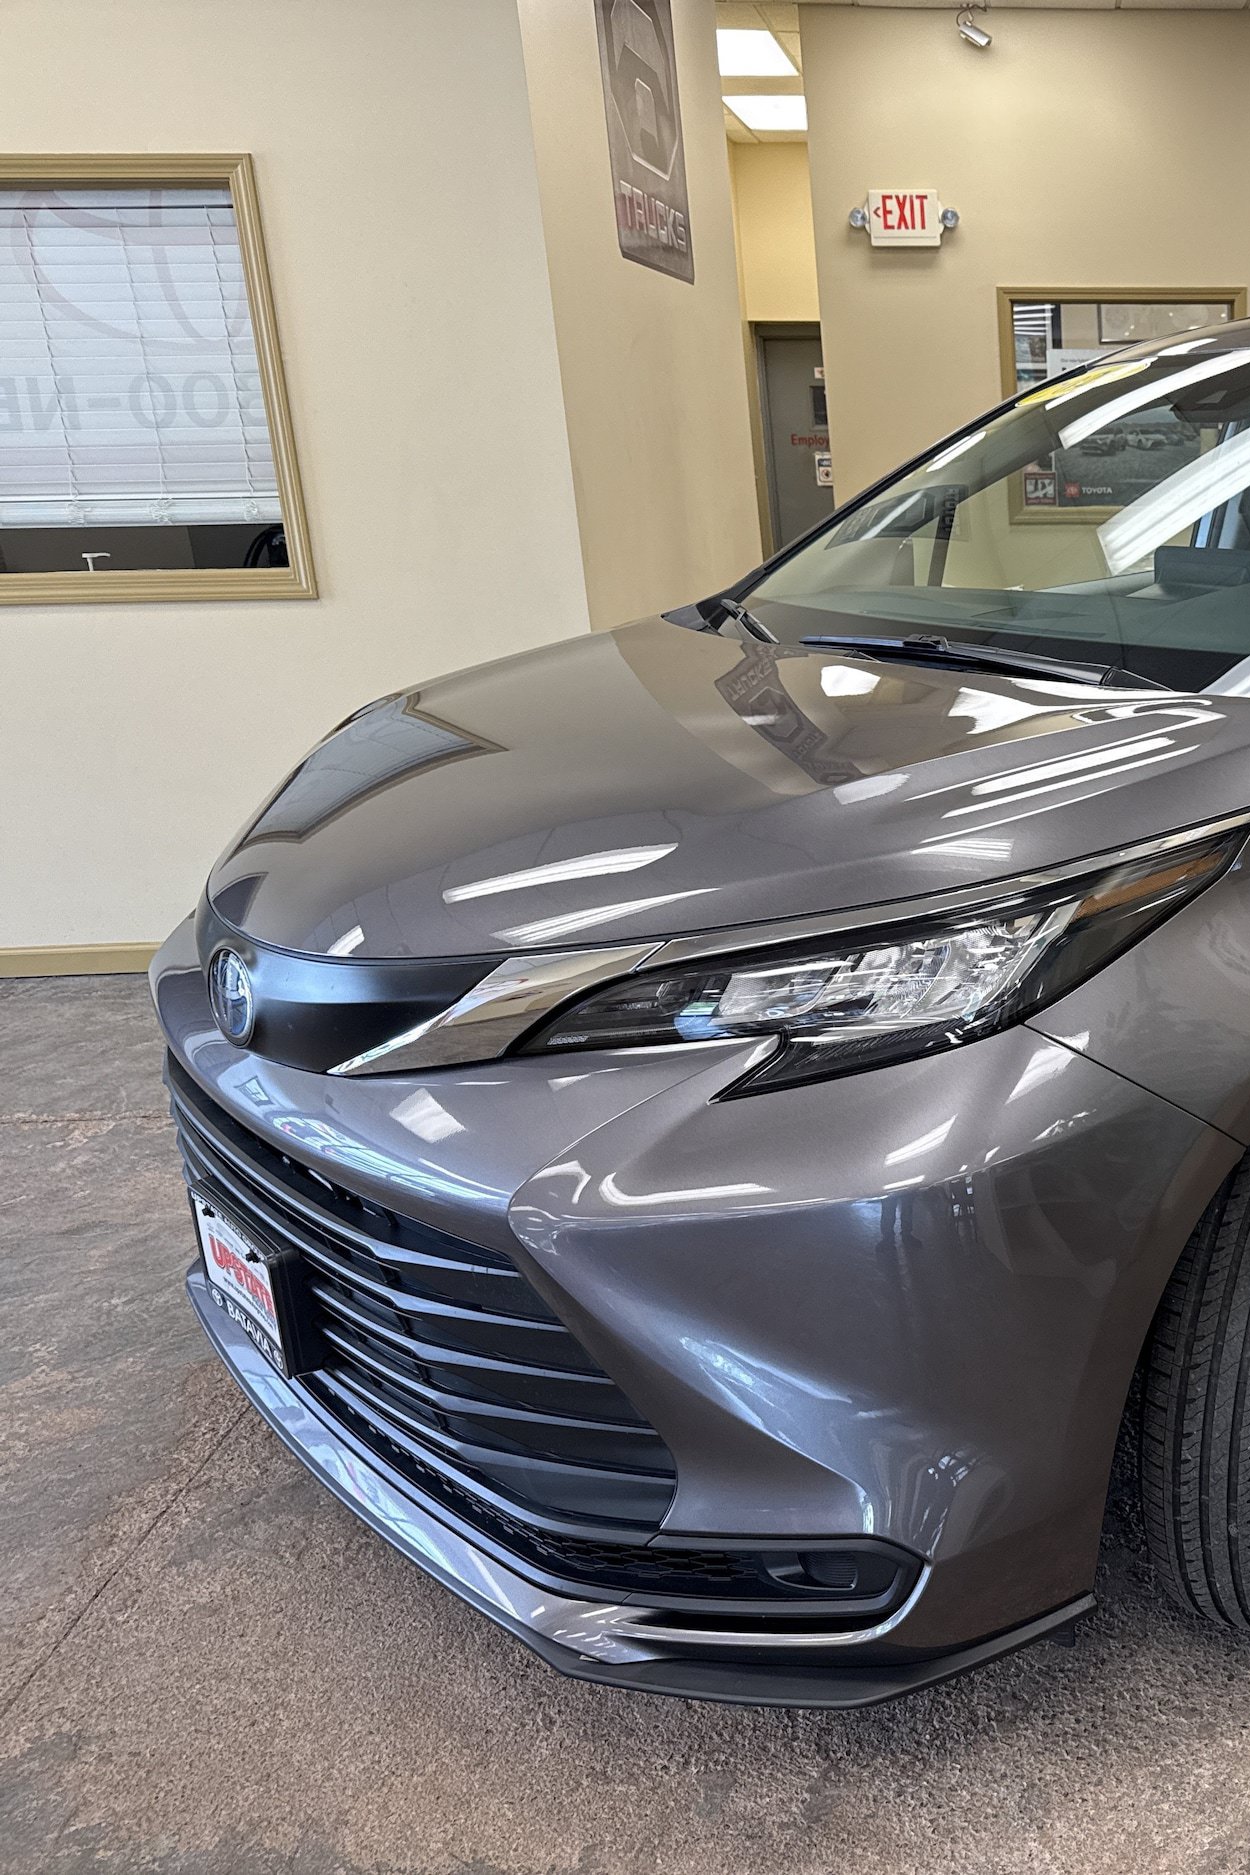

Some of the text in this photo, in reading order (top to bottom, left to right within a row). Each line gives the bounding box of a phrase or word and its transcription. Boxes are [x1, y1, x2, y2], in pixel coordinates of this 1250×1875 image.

[619, 180, 687, 253] TRUCKS
[882, 194, 928, 230] EXIT
[1082, 486, 1112, 494] TOYOTA
[208, 1233, 275, 1318] UPSTATE
[226, 1300, 272, 1358] BATAVIA
